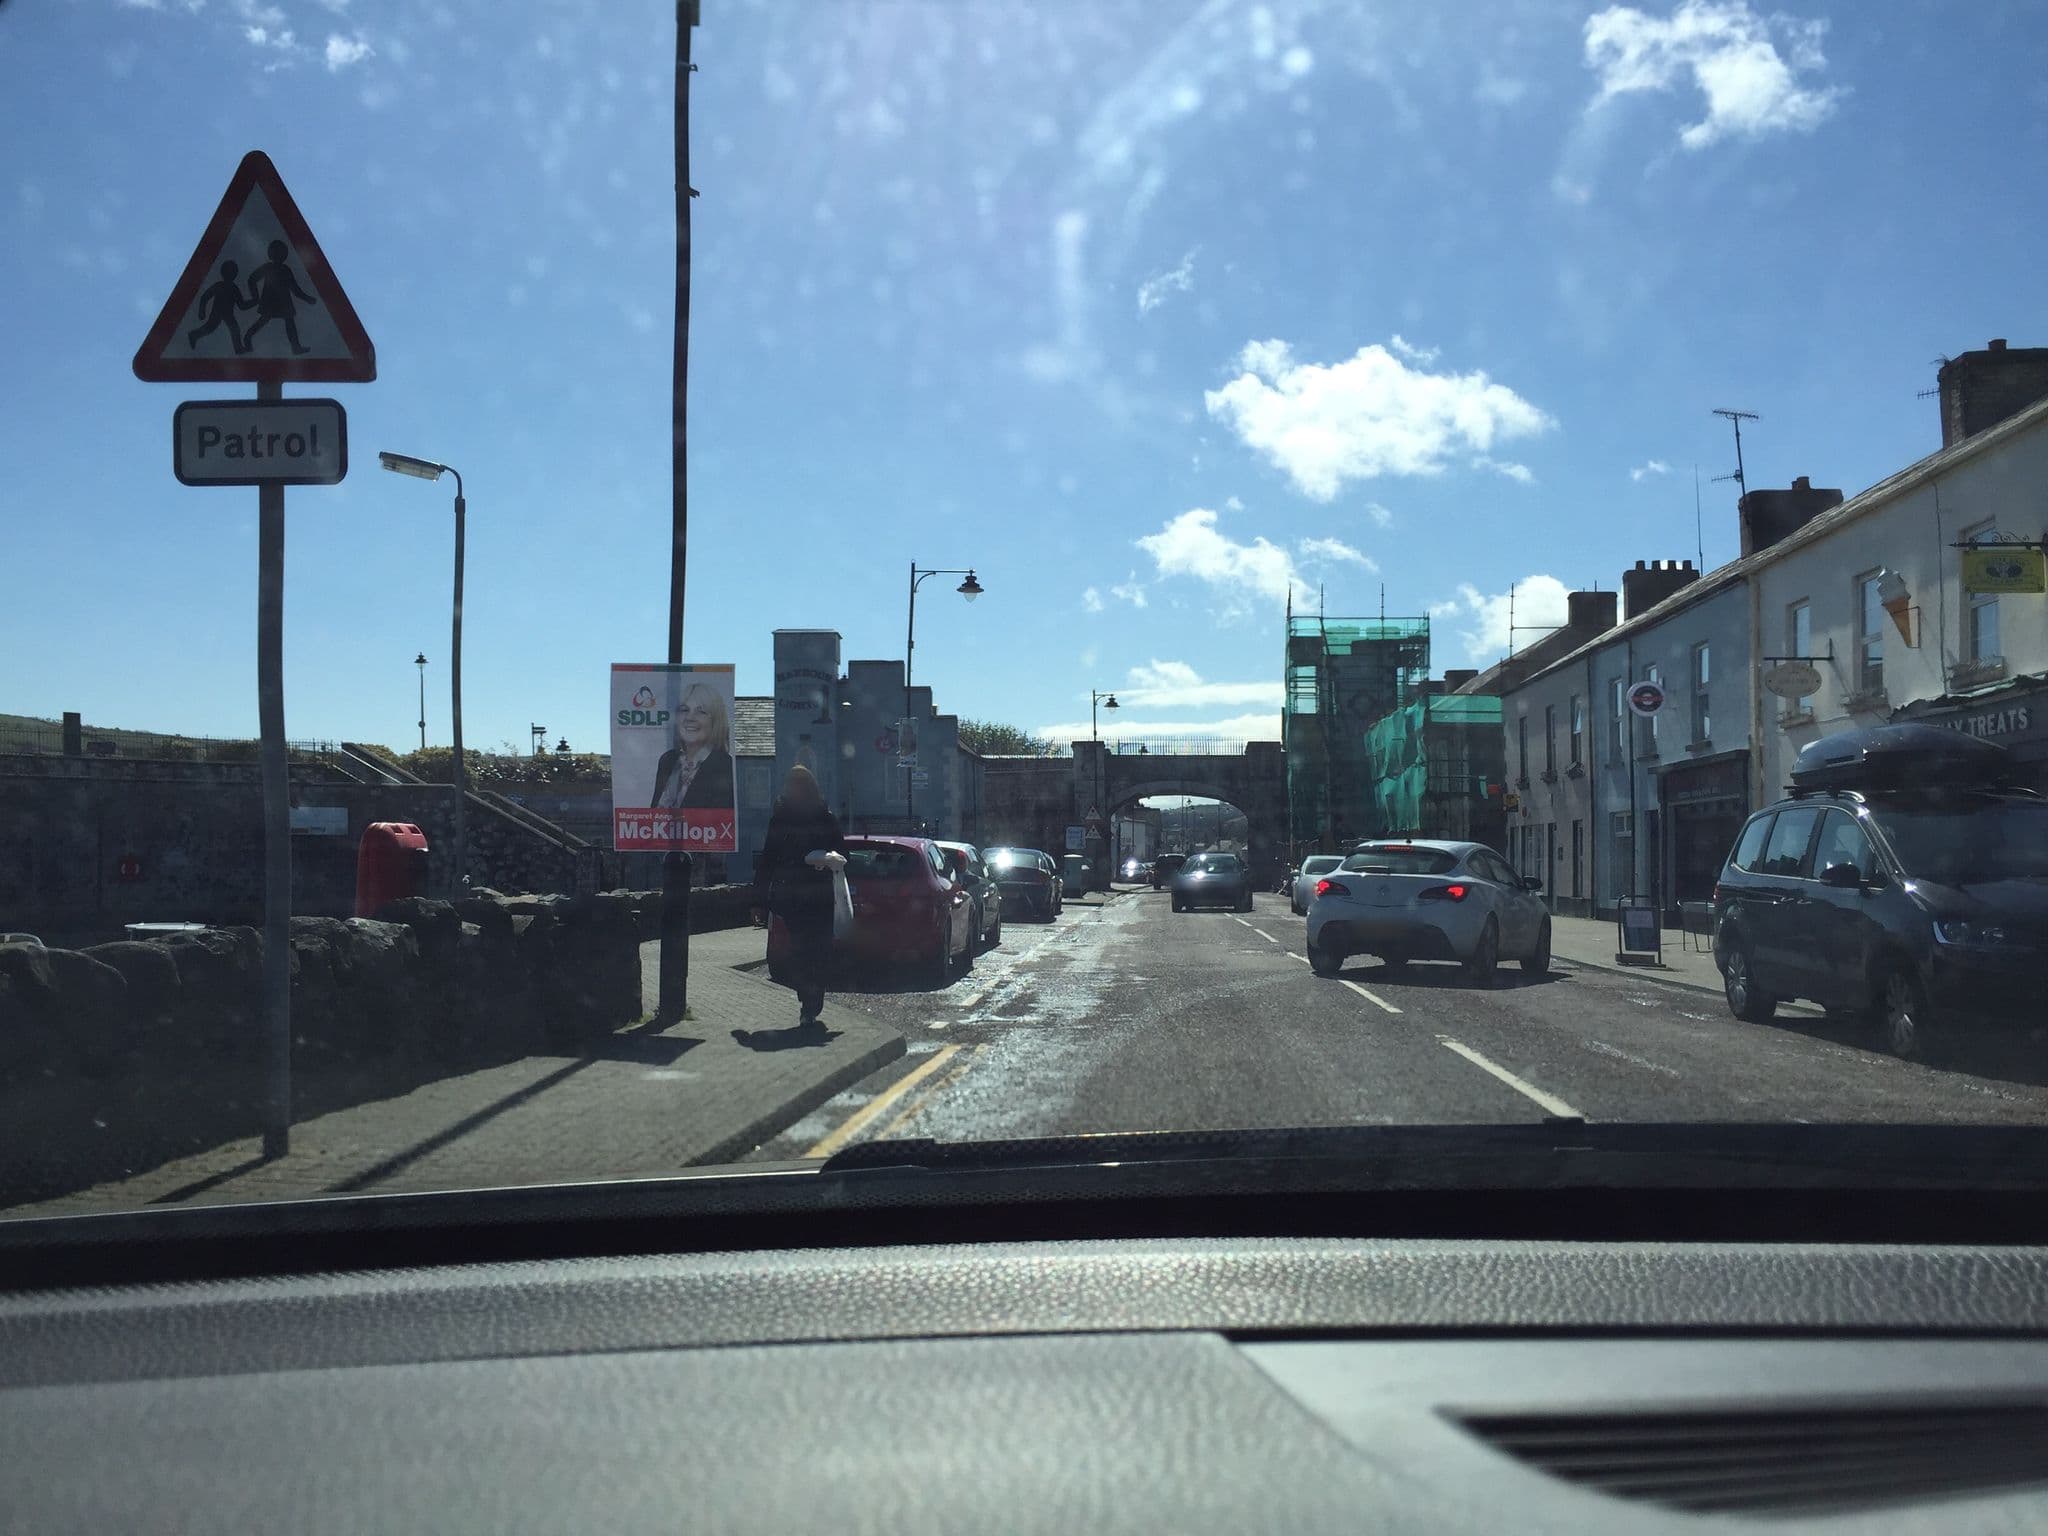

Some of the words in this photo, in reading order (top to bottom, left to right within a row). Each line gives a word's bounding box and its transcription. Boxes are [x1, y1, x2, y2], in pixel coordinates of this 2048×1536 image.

[197, 423, 321, 459] Patrol
[617, 709, 671, 726] SDLP
[1967, 707, 2029, 737] TREATS
[618, 821, 717, 844] McKillop
